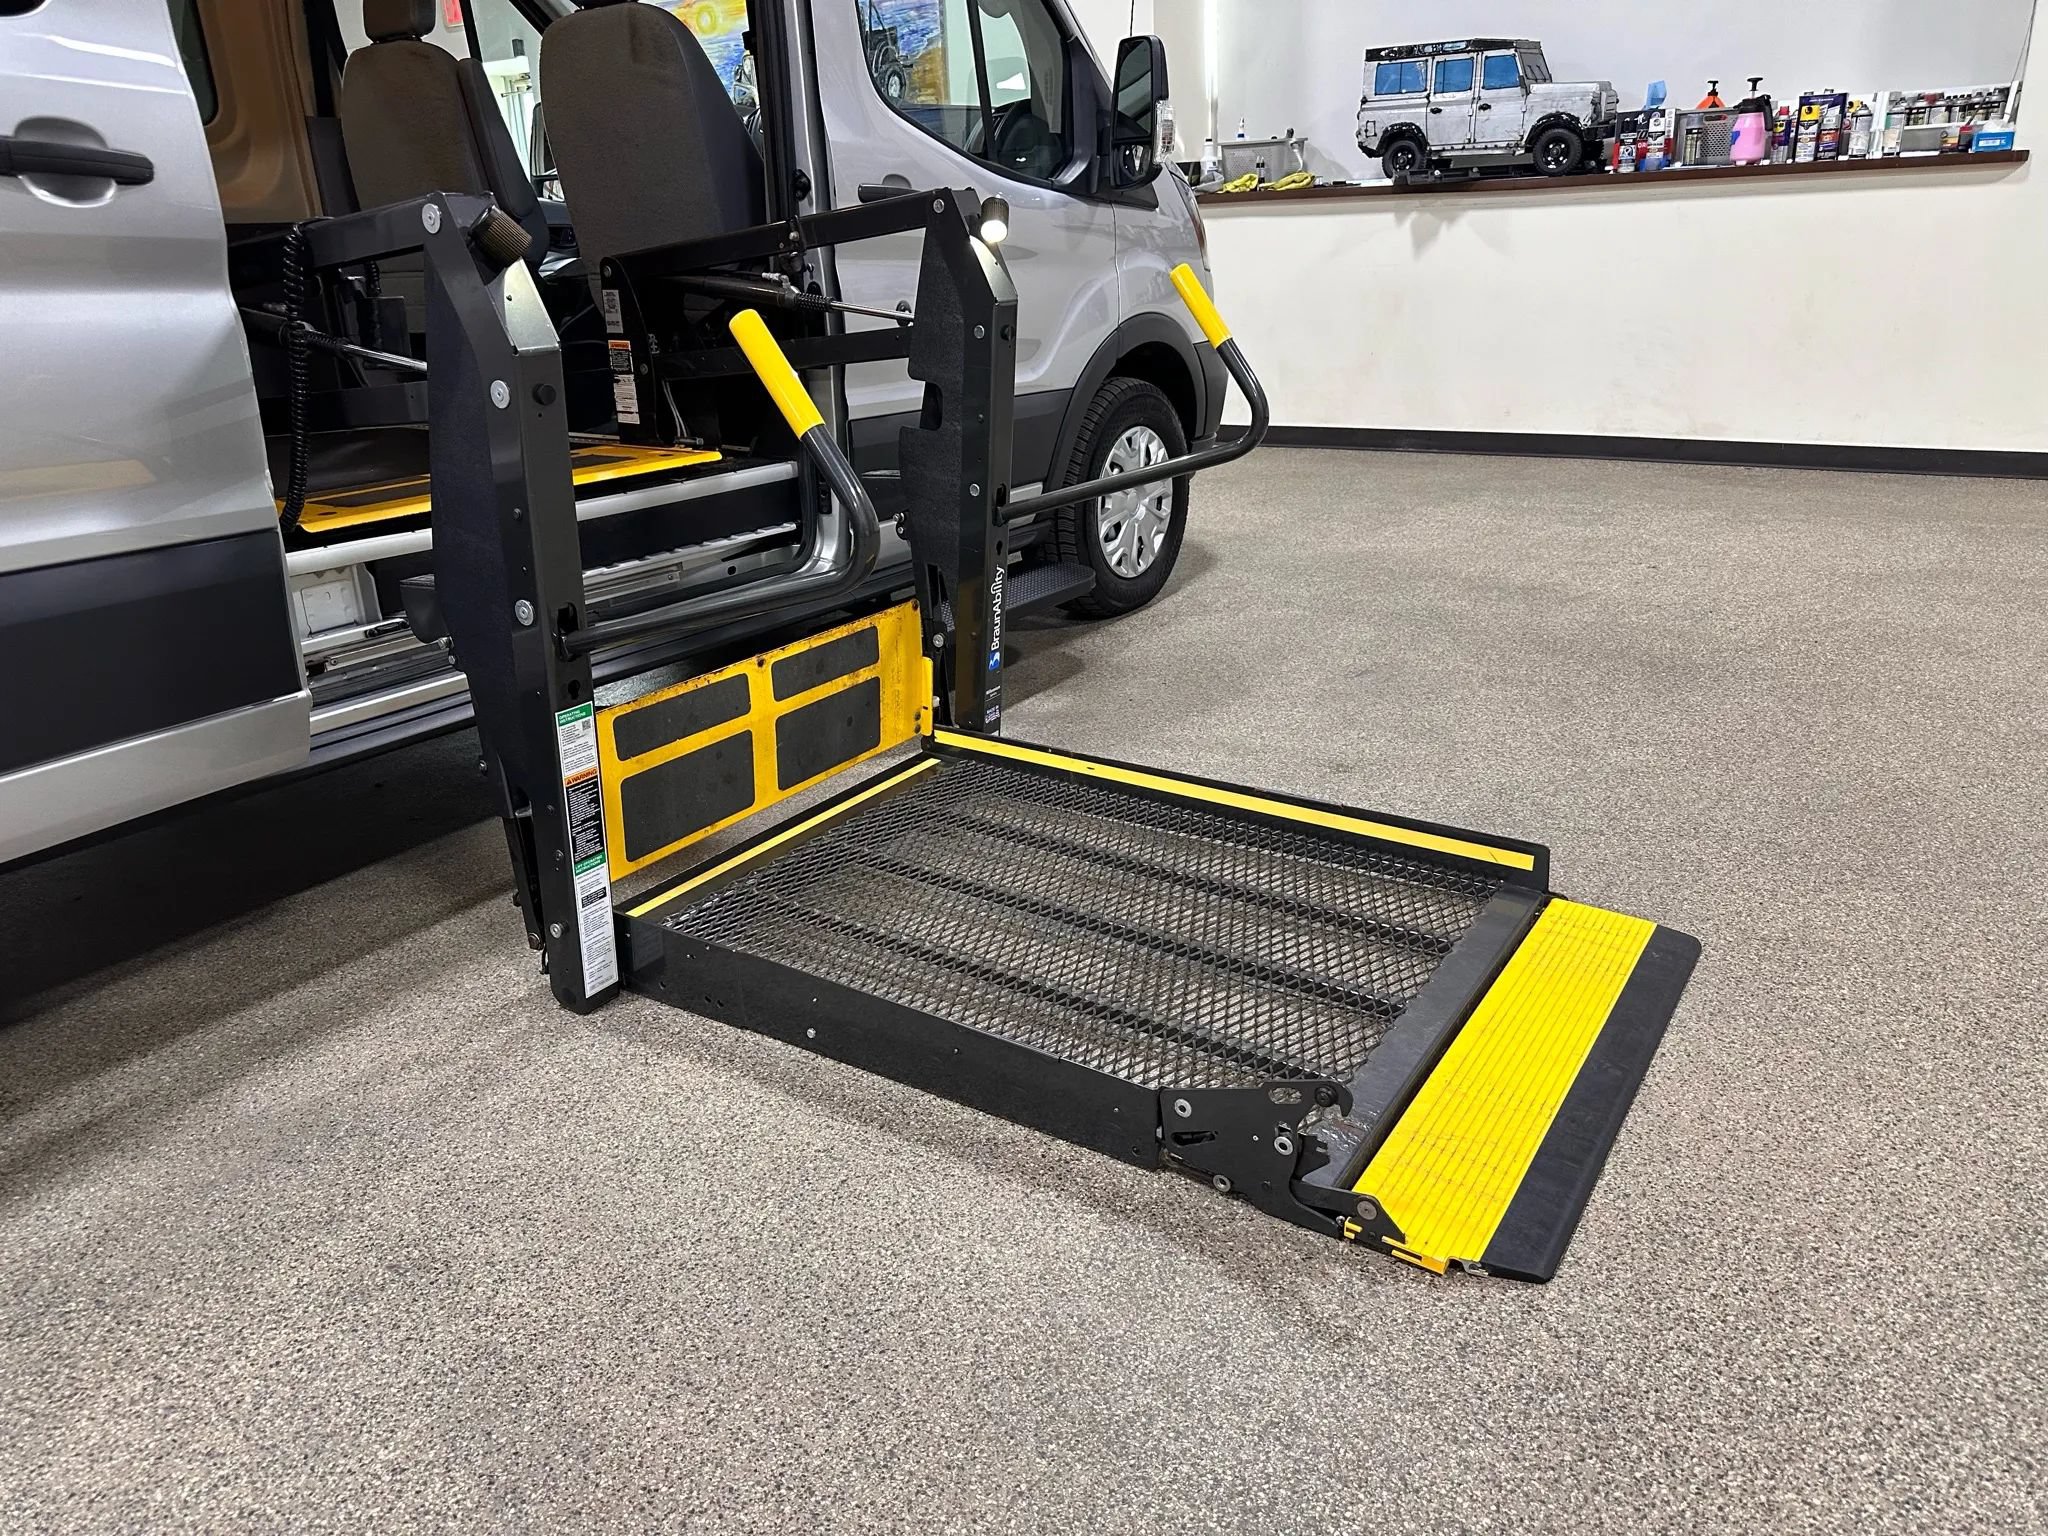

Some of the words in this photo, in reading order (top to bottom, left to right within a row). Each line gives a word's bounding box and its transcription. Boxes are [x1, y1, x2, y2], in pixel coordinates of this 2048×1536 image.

[991, 565, 1005, 650] BraunAbility
[559, 710, 580, 720] OPERATING
[559, 712, 586, 723] INSTRUCTIONS
[572, 769, 597, 782] WARNING
